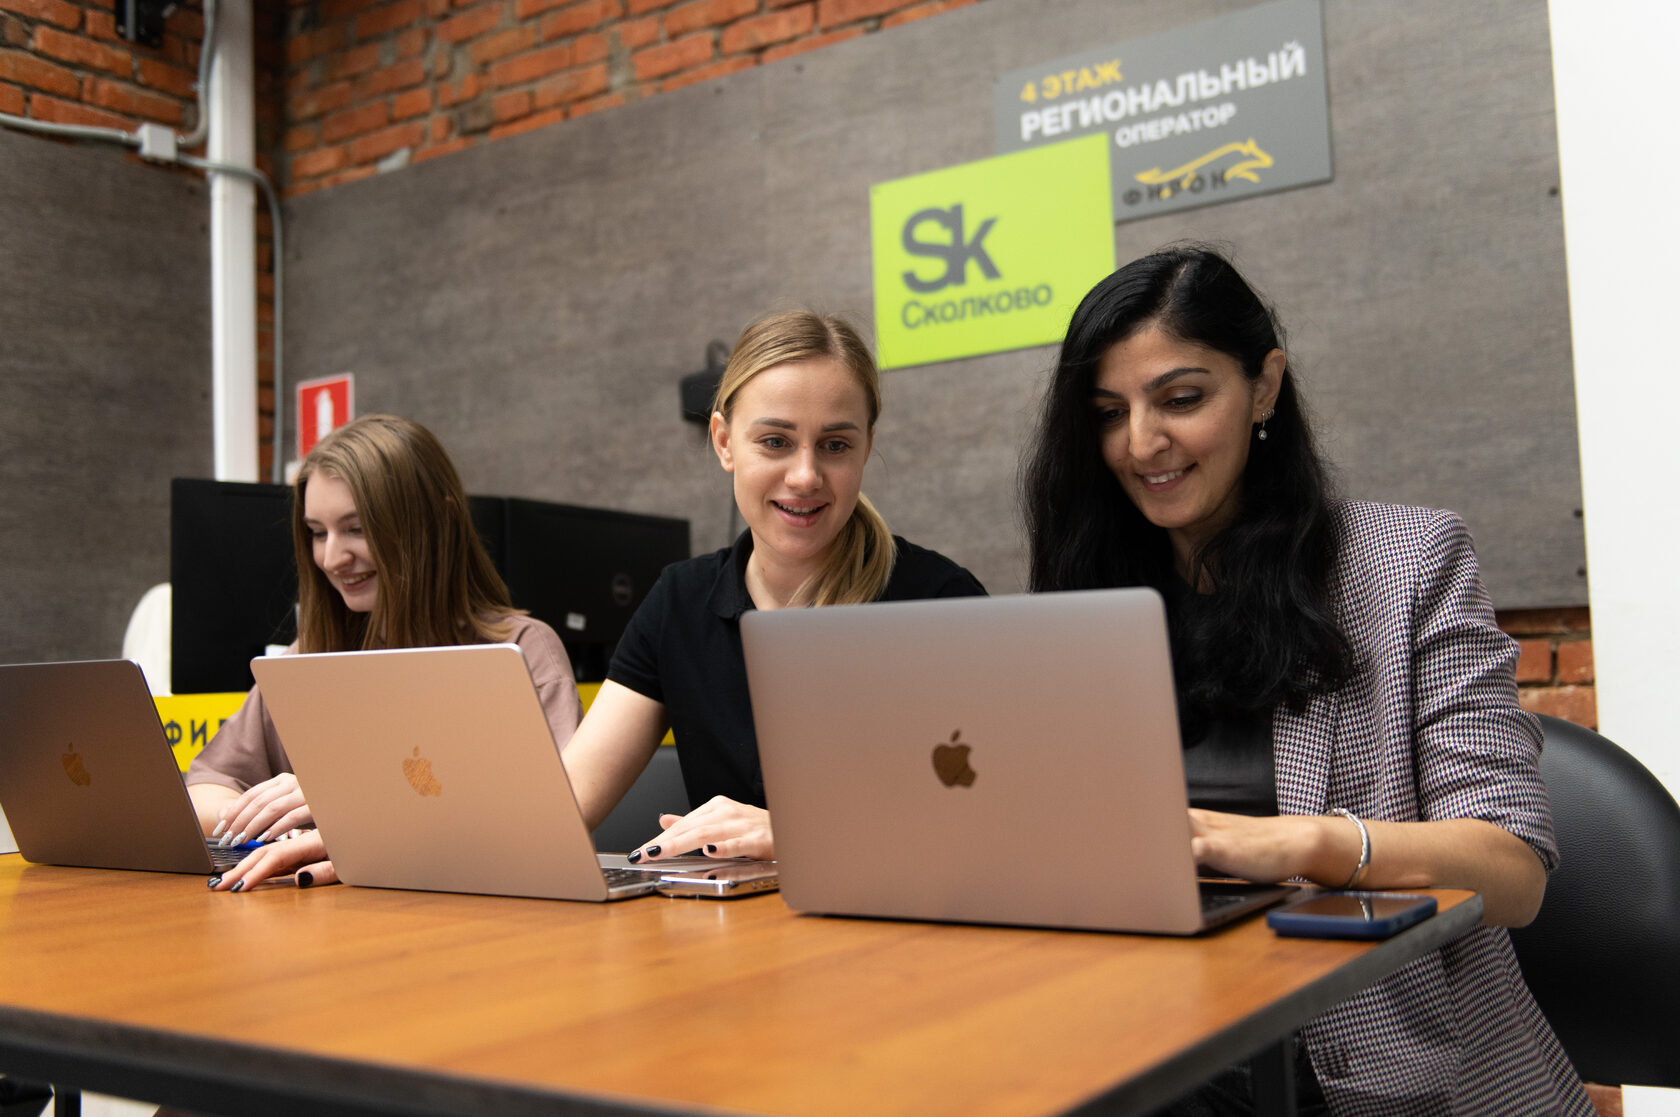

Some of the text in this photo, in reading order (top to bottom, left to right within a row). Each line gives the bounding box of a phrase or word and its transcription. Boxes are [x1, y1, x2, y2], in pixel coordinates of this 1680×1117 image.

[1019, 40, 1308, 142] РЕГИОНАЛЬНЫЙ
[1020, 59, 1124, 104] 4 ЭТАЖ
[1115, 102, 1238, 148] ОПЕРАТОР
[901, 202, 1002, 294] Sk
[164, 719, 228, 748] ФИ
